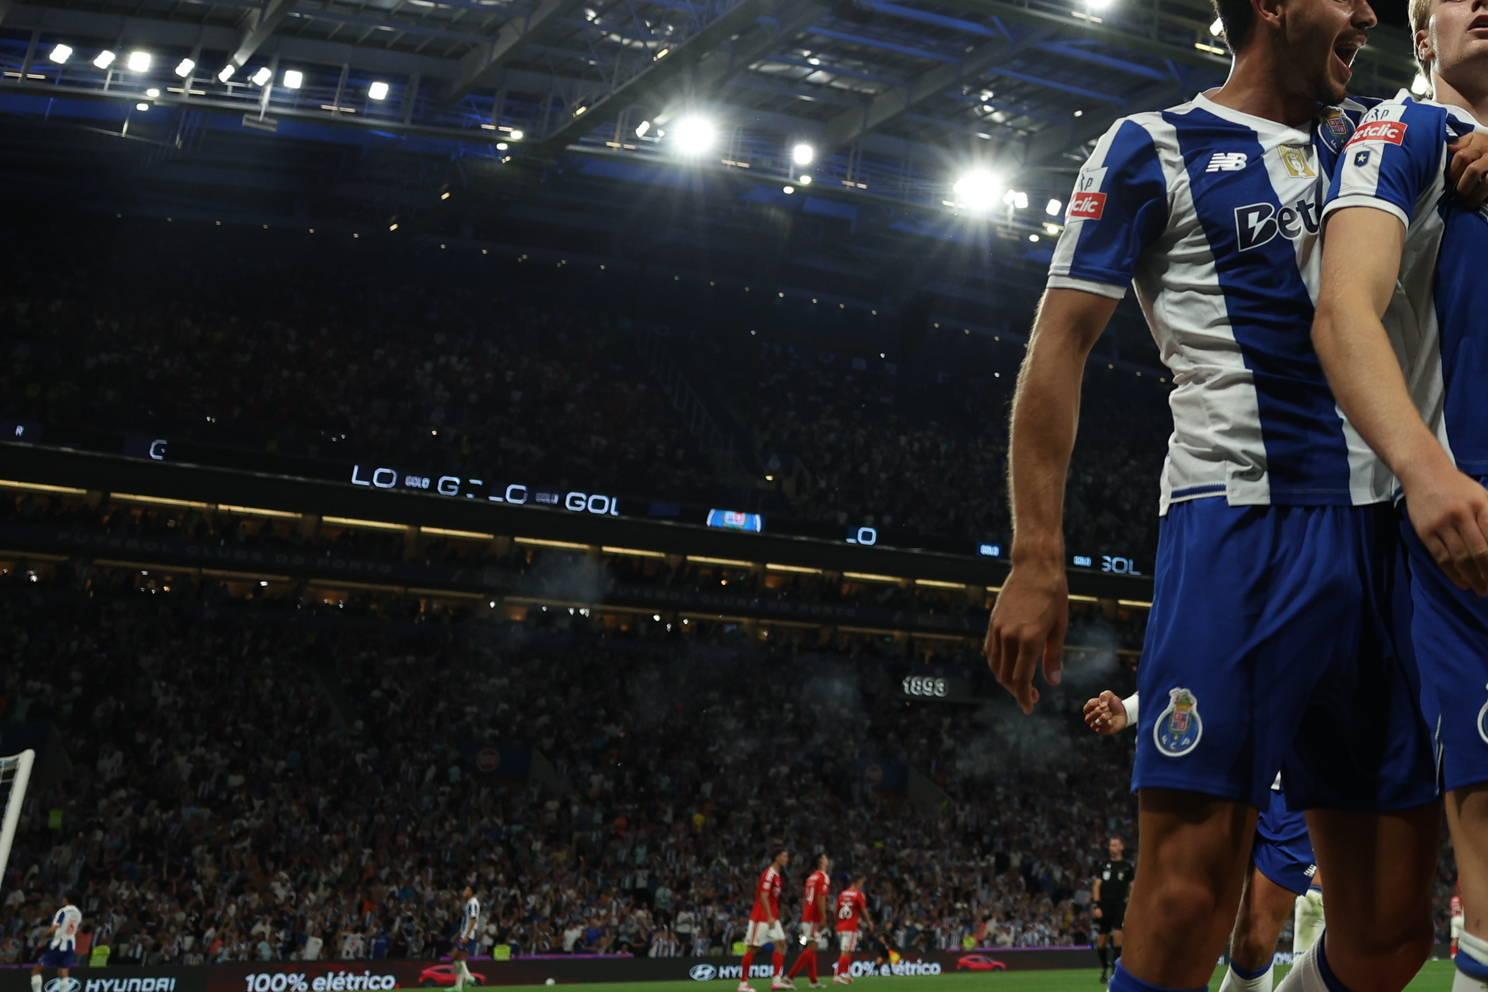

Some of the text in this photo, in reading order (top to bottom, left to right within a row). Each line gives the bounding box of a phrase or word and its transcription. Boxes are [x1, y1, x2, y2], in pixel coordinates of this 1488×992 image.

[1353, 123, 1399, 139] etclic
[1071, 196, 1099, 213] clic
[1234, 198, 1320, 252] Bet
[902, 676, 947, 697] 1893
[85, 977, 176, 992] HYUNDAI
[245, 969, 396, 992] 100% elétrico
